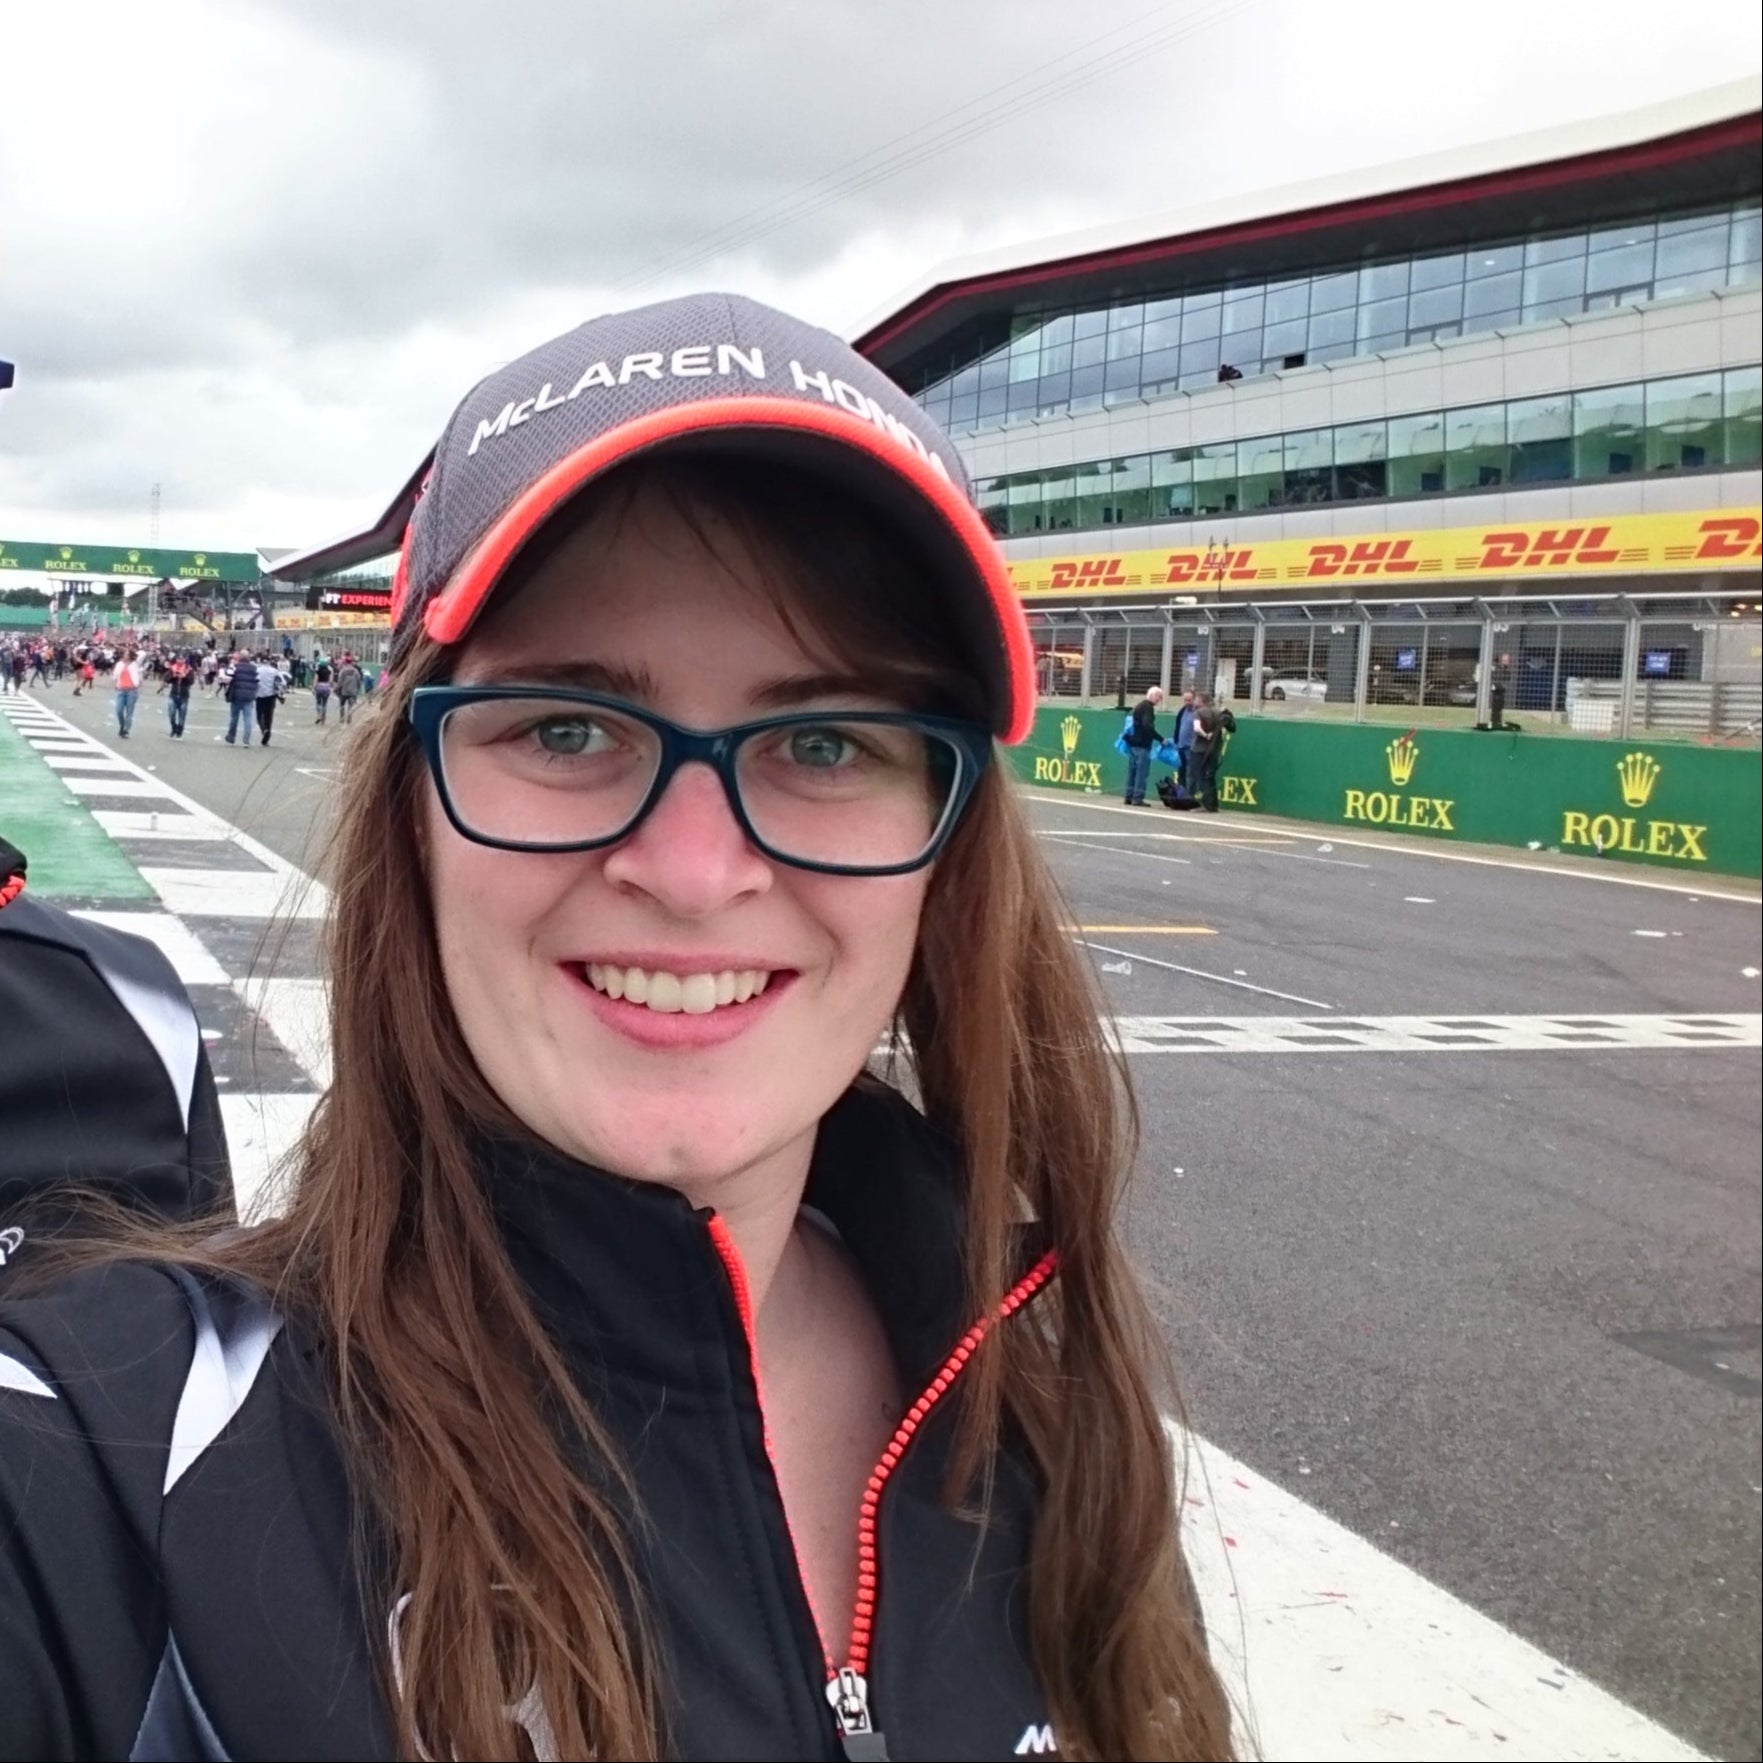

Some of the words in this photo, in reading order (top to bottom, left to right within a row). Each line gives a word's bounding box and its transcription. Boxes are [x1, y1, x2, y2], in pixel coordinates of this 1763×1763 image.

[468, 344, 766, 456] McLAREN
[1307, 540, 1420, 576] DHL
[1479, 527, 1620, 568] DHL
[45, 560, 87, 571] ROLEX
[113, 563, 155, 574] ROLEX
[180, 566, 220, 577] ROLEX
[1050, 559, 1126, 589] DHL
[1166, 551, 1258, 583] DHL
[1034, 757, 1101, 786] ROLEX
[1343, 790, 1455, 830] ROLEX
[1561, 811, 1707, 861] ROLEX
